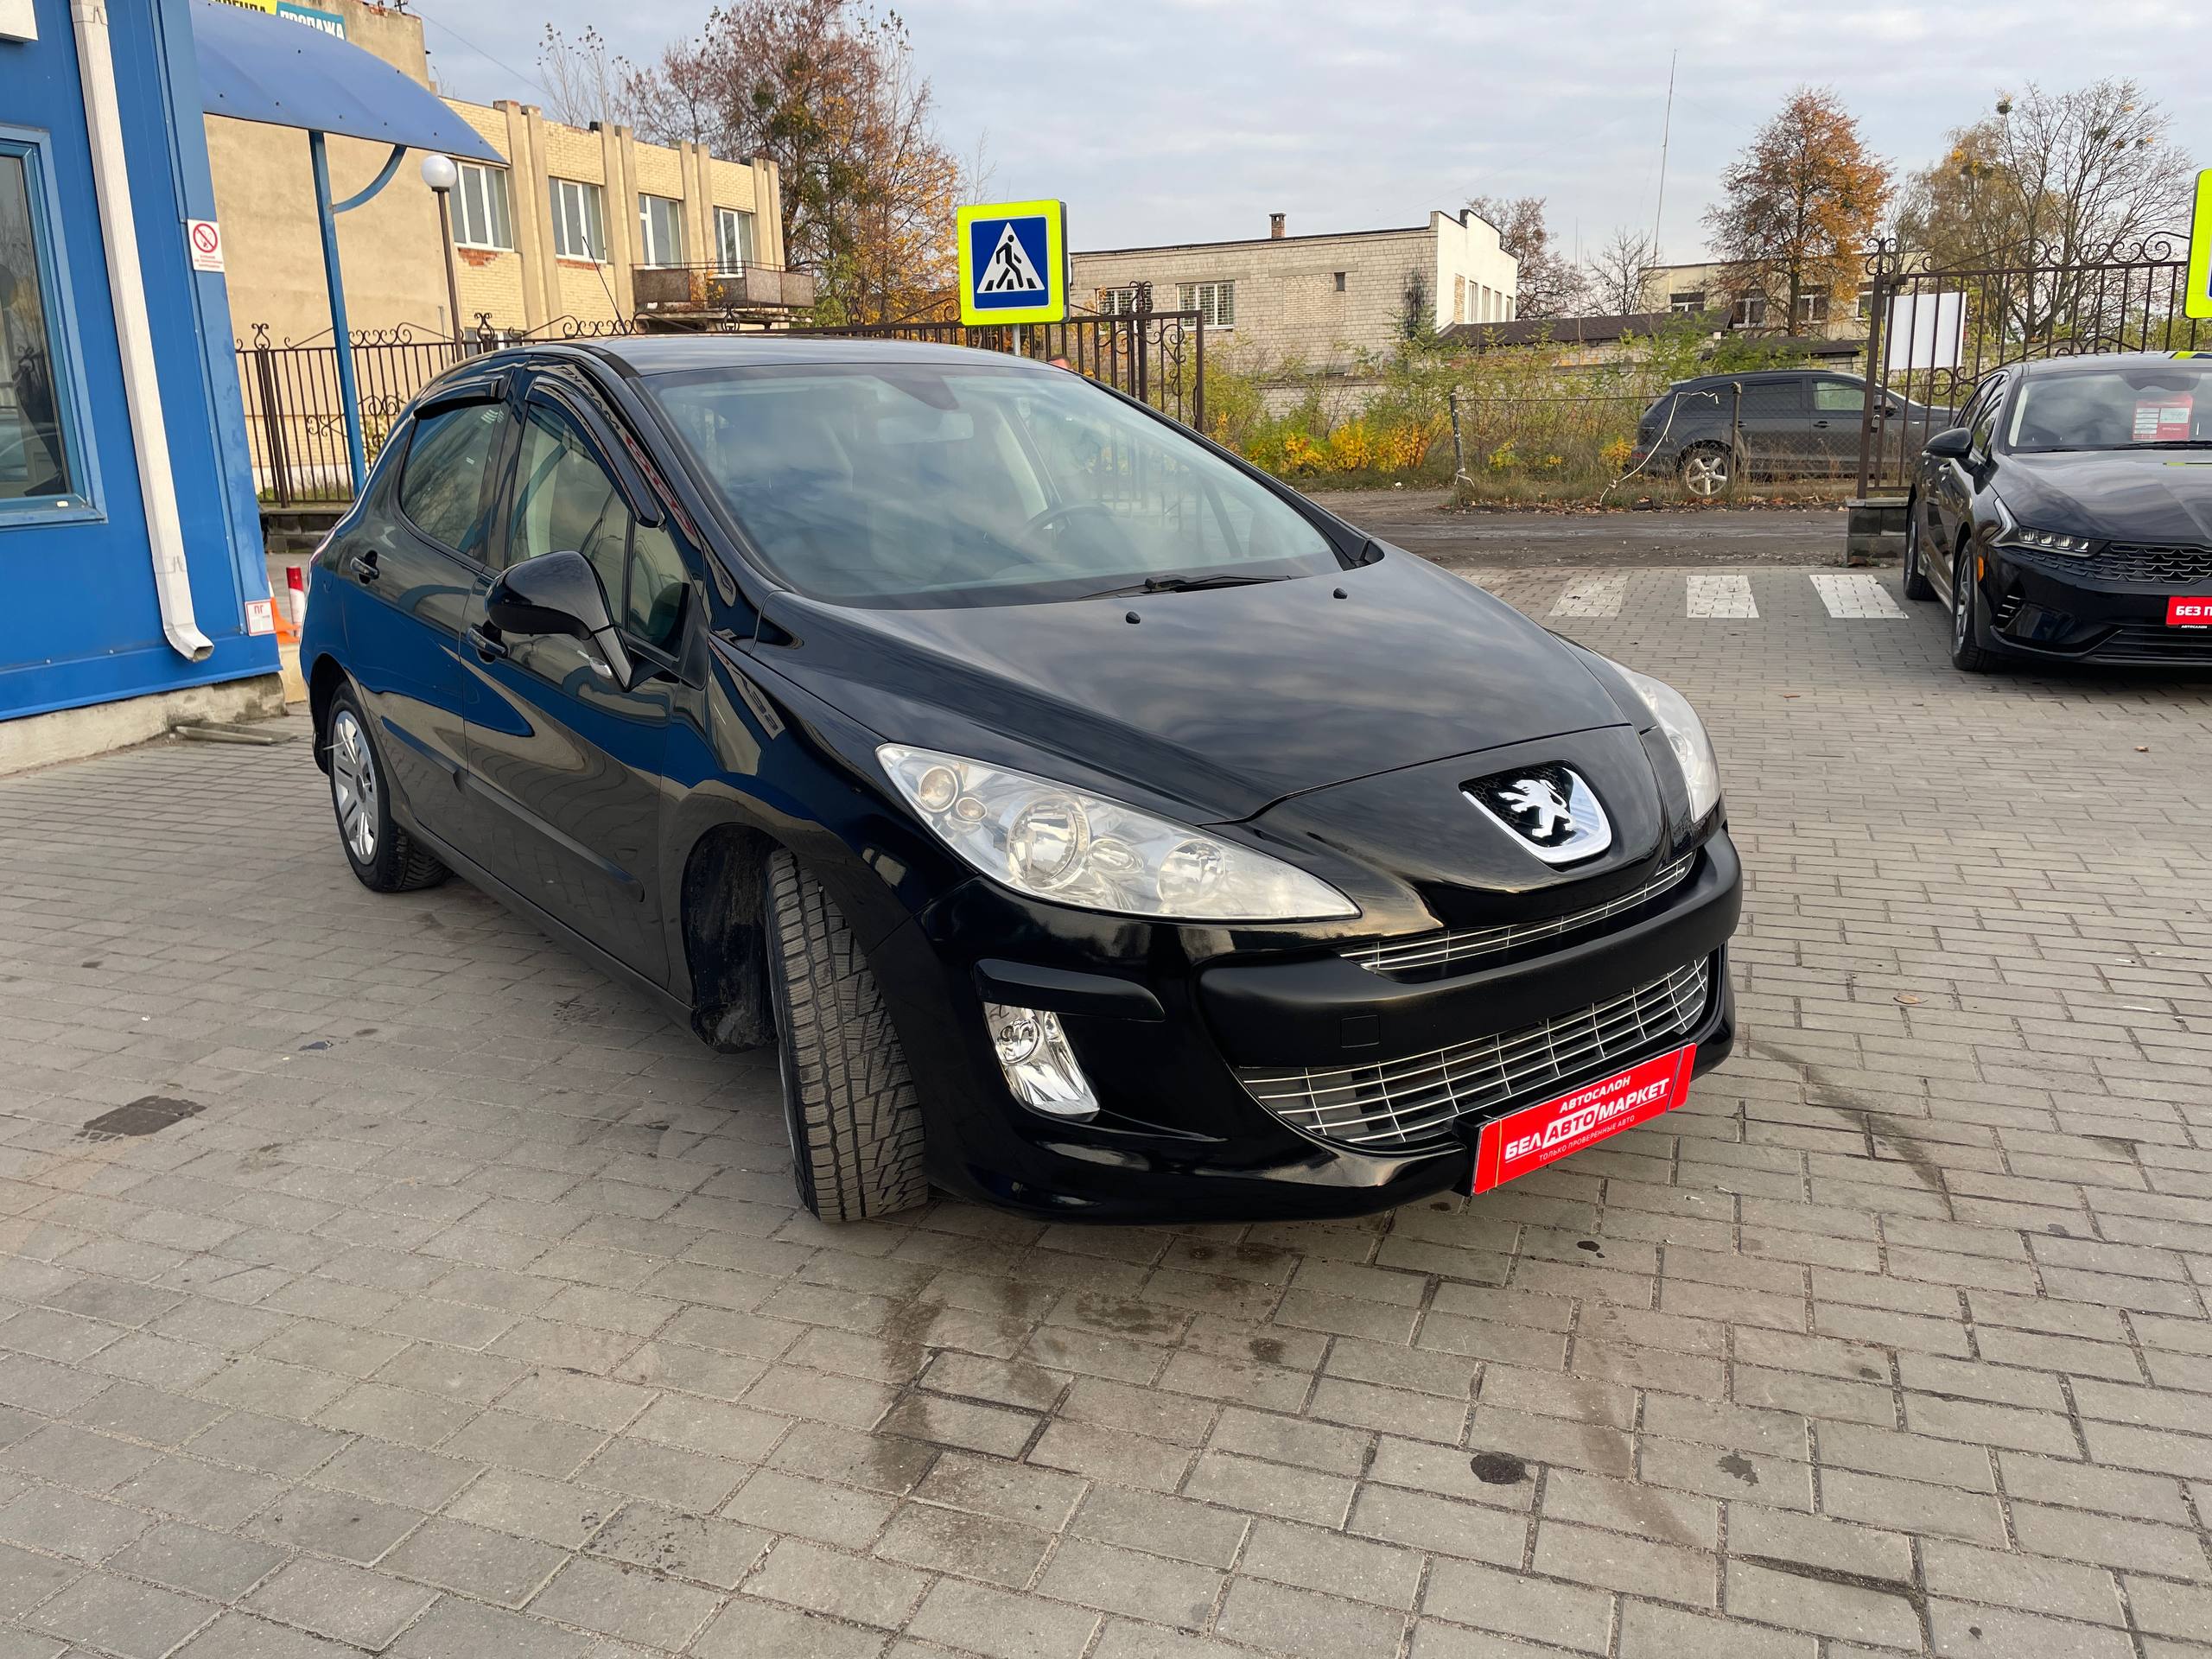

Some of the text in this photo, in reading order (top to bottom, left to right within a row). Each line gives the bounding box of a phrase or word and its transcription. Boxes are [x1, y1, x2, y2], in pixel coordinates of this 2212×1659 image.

[2176, 606, 2201, 616] БЕЗ
[1559, 1076, 1631, 1114] АВТОСАЛОН
[1539, 1115, 1636, 1161] ТОЛЬКО ПРОВЕРЕННЫЕ АВТО
